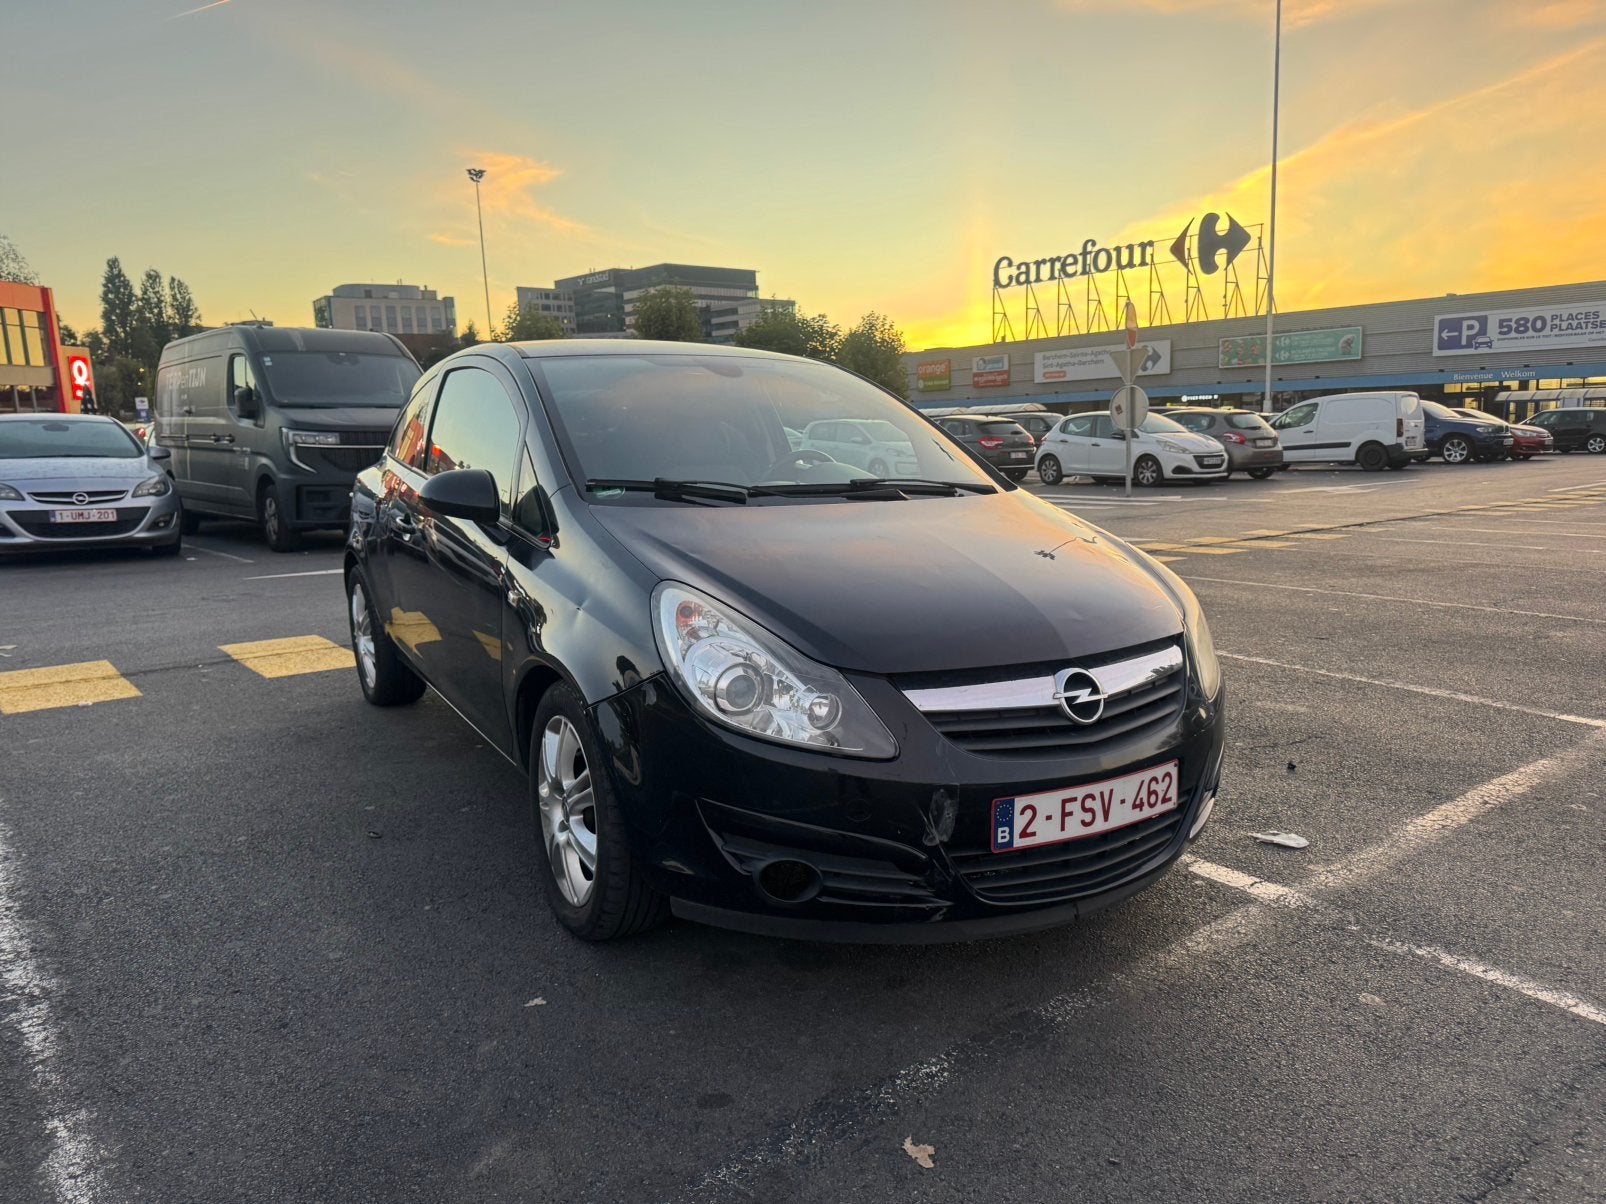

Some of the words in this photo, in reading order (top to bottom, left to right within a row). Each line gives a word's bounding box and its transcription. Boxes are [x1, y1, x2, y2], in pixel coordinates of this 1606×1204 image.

[993, 238, 1155, 289] Carrefour
[1550, 310, 1601, 323] PLACES
[1461, 319, 1480, 346] P
[1498, 315, 1548, 336] 580
[1550, 319, 1606, 333] PLAATSE
[917, 363, 947, 375] orange
[1453, 372, 1494, 381] Bienvenue
[1501, 369, 1536, 379] Welkom
[58, 510, 115, 520] 1-UMJ-201
[997, 827, 1010, 843] B
[1018, 771, 1173, 840] 2-FSV-462
